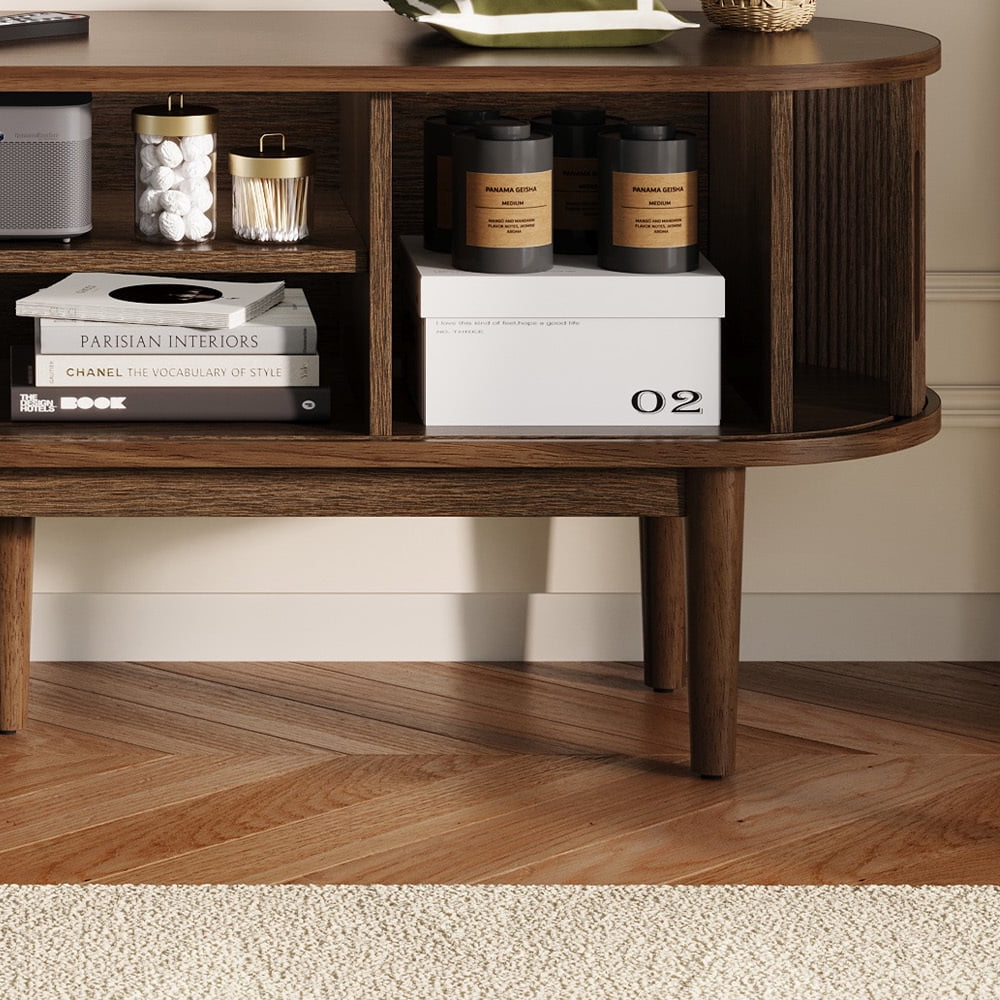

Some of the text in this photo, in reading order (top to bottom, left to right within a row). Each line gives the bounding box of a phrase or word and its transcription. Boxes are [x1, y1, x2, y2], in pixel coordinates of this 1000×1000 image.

[81, 335, 259, 348] PARISIAN INTERIORS
[66, 367, 282, 378] CHANEL THE VOCABULARY OF STYLE
[19, 393, 38, 401] THE
[630, 389, 704, 415] 02
[20, 399, 54, 407] DESIGN
[60, 396, 127, 410] BOOK
[20, 405, 56, 413] HOTELS
